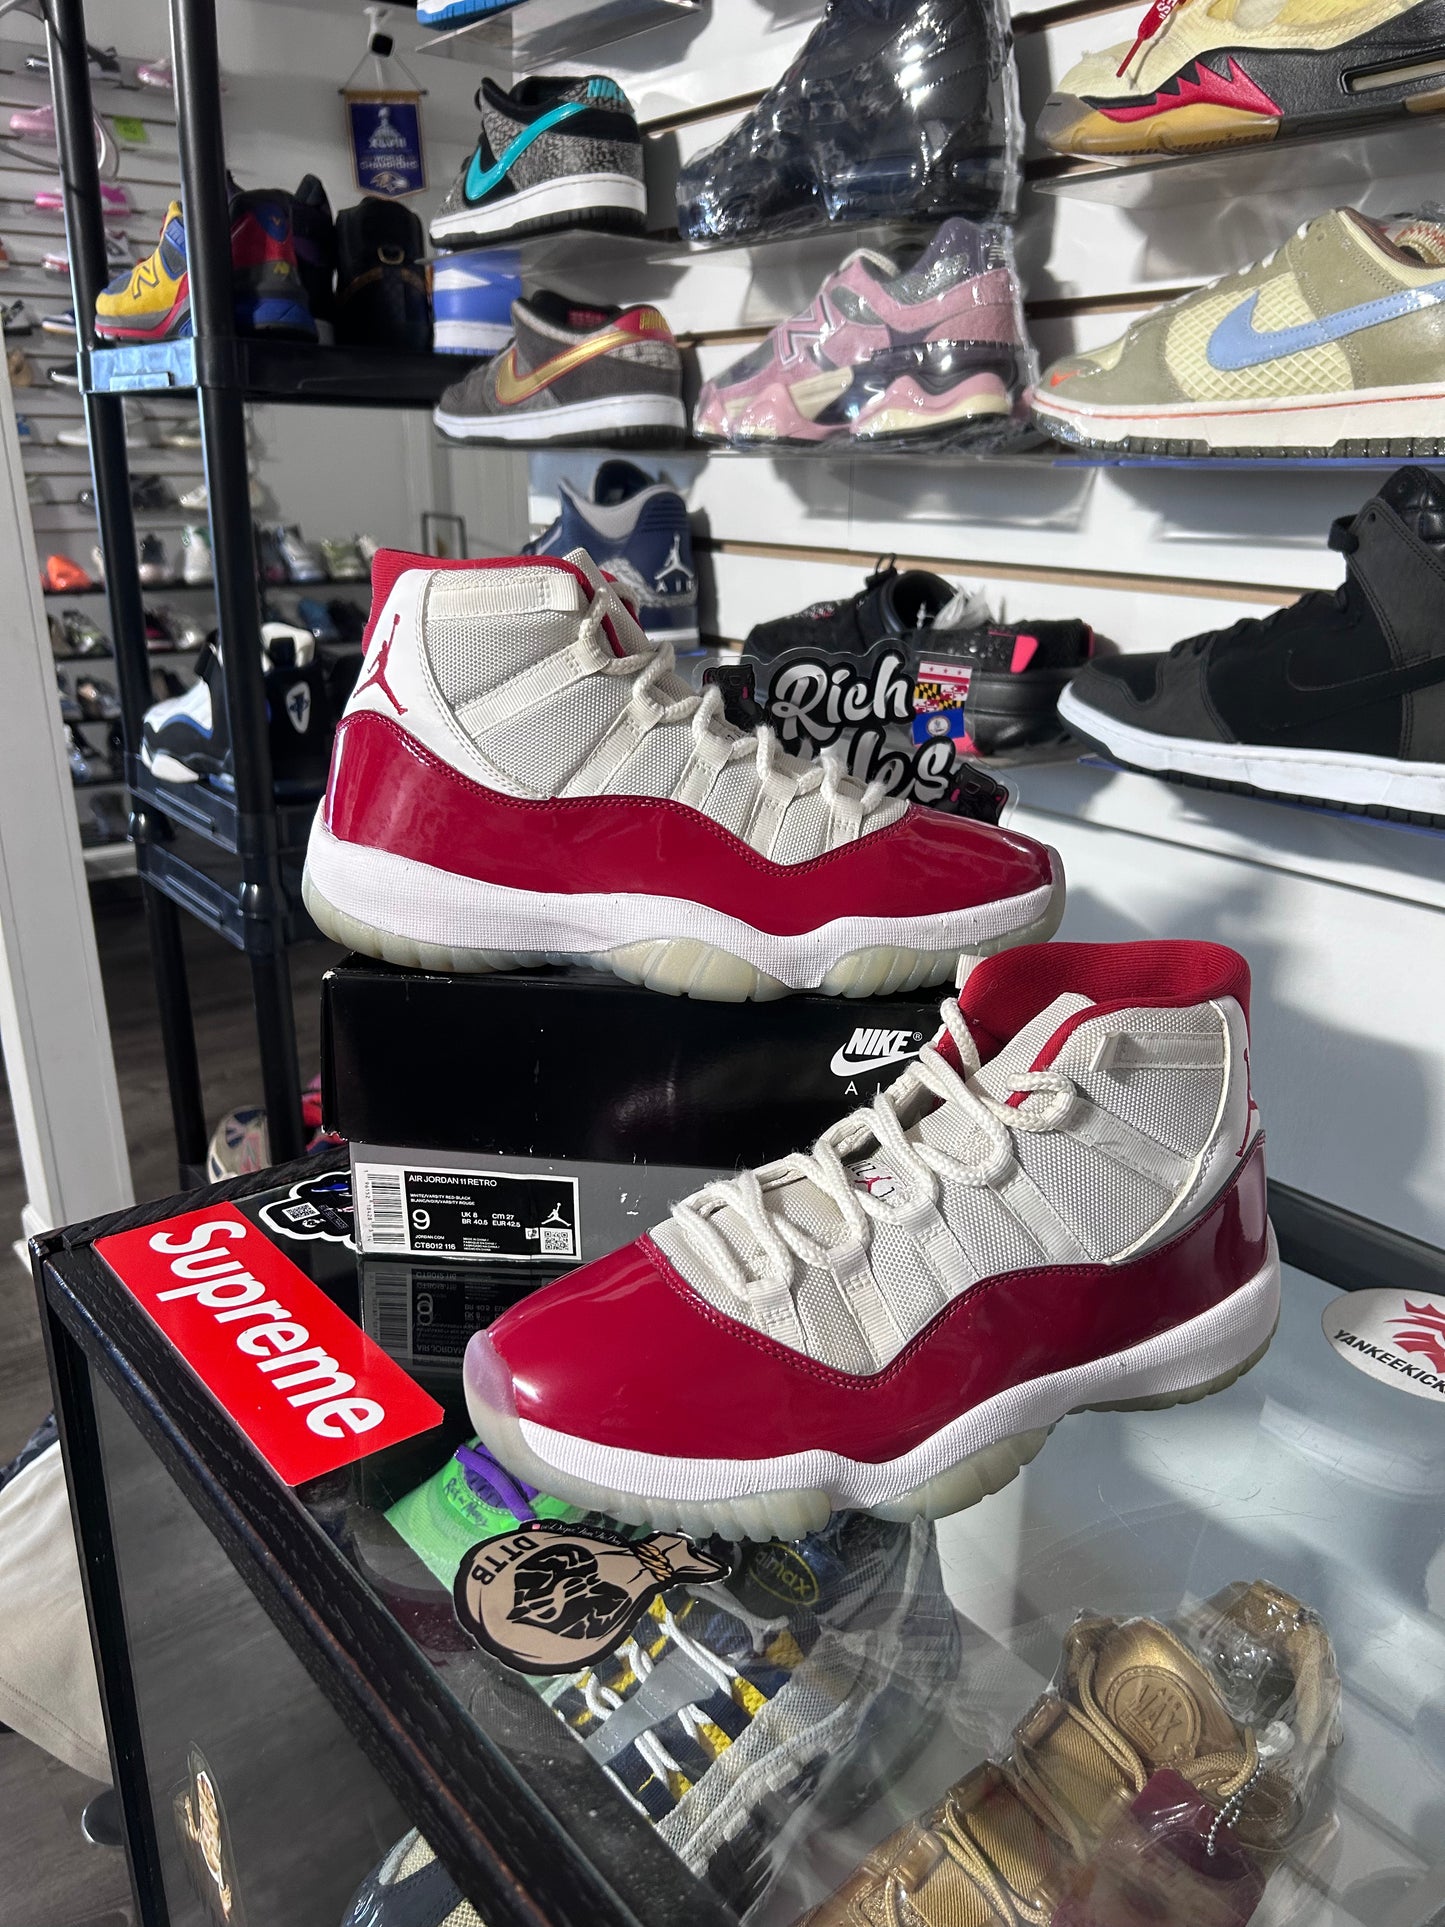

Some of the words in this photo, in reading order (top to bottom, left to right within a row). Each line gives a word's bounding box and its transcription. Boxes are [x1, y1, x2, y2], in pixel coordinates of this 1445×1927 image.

[771, 655, 909, 741] Rich
[844, 1027, 913, 1057] NIKE
[844, 1080, 881, 1096] AI
[408, 1174, 423, 1183] AIR
[423, 1175, 460, 1185] JORDAN
[467, 1178, 498, 1187] RETRO
[411, 1208, 431, 1230] 9
[414, 1241, 443, 1250] CT8012
[148, 1220, 386, 1439] Supreme
[471, 1535, 541, 1585] DTTB
